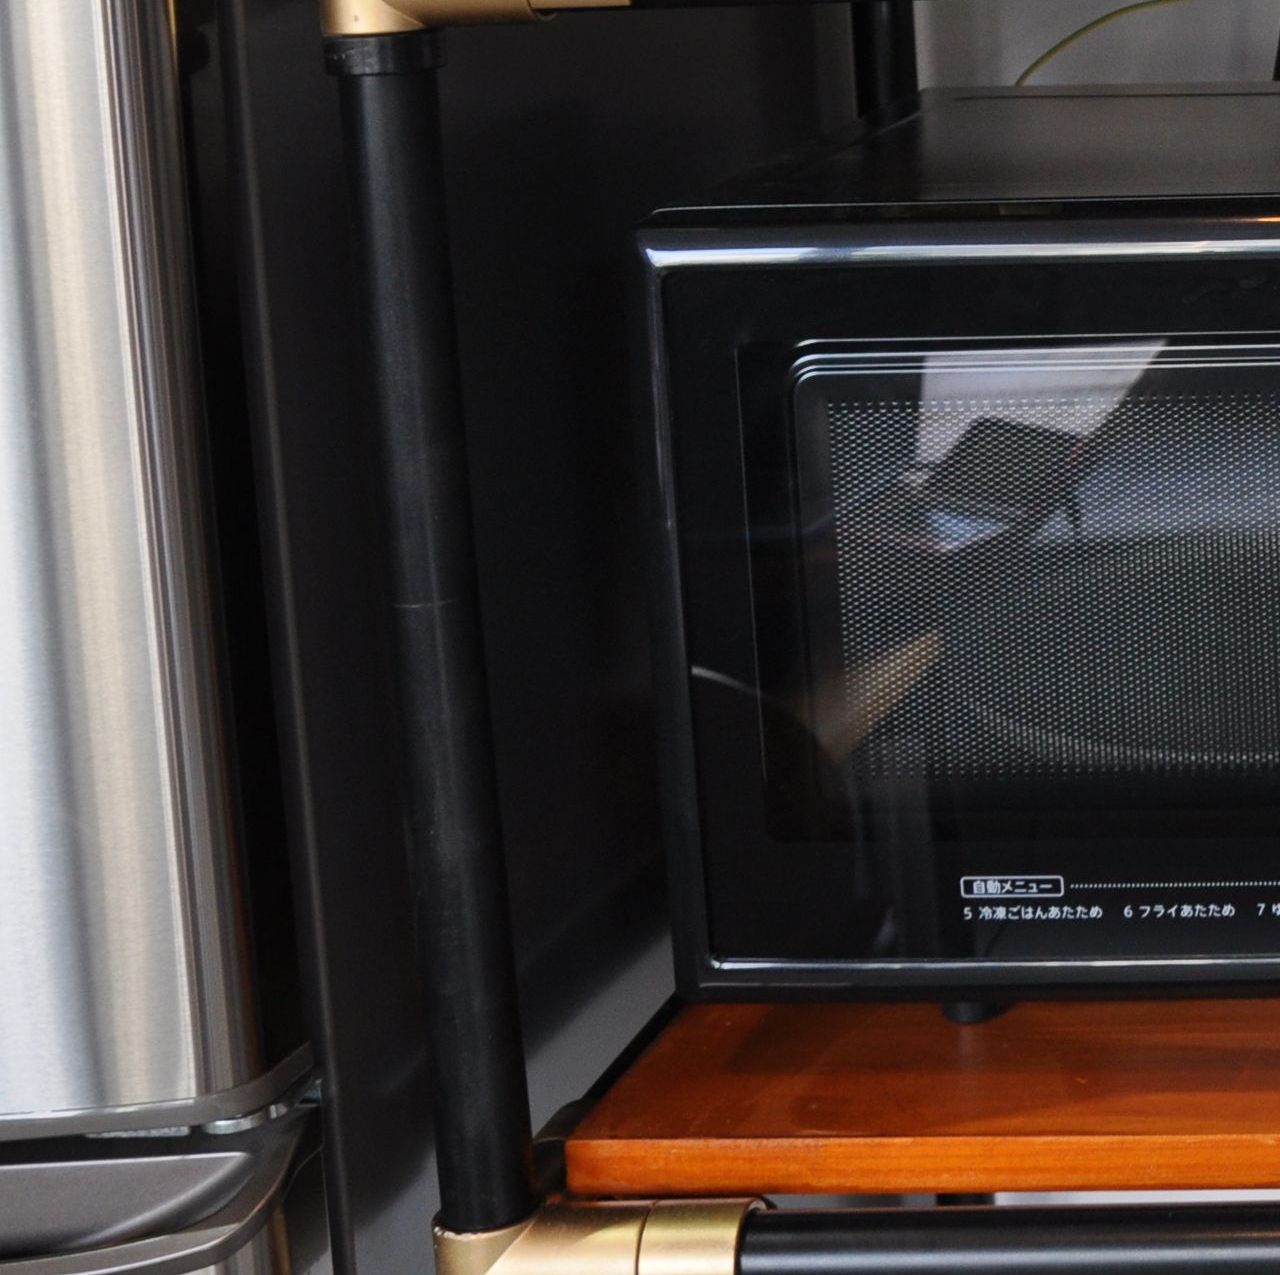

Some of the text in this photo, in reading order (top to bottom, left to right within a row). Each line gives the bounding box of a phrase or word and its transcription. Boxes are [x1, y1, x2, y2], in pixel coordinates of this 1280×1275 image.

[972, 879, 1053, 894] 自動メニュー
[963, 905, 1103, 920] 5 冷凍ごはんあたため
[1123, 904, 1236, 918] 6 フライあたため
[1257, 903, 1266, 916] 7
